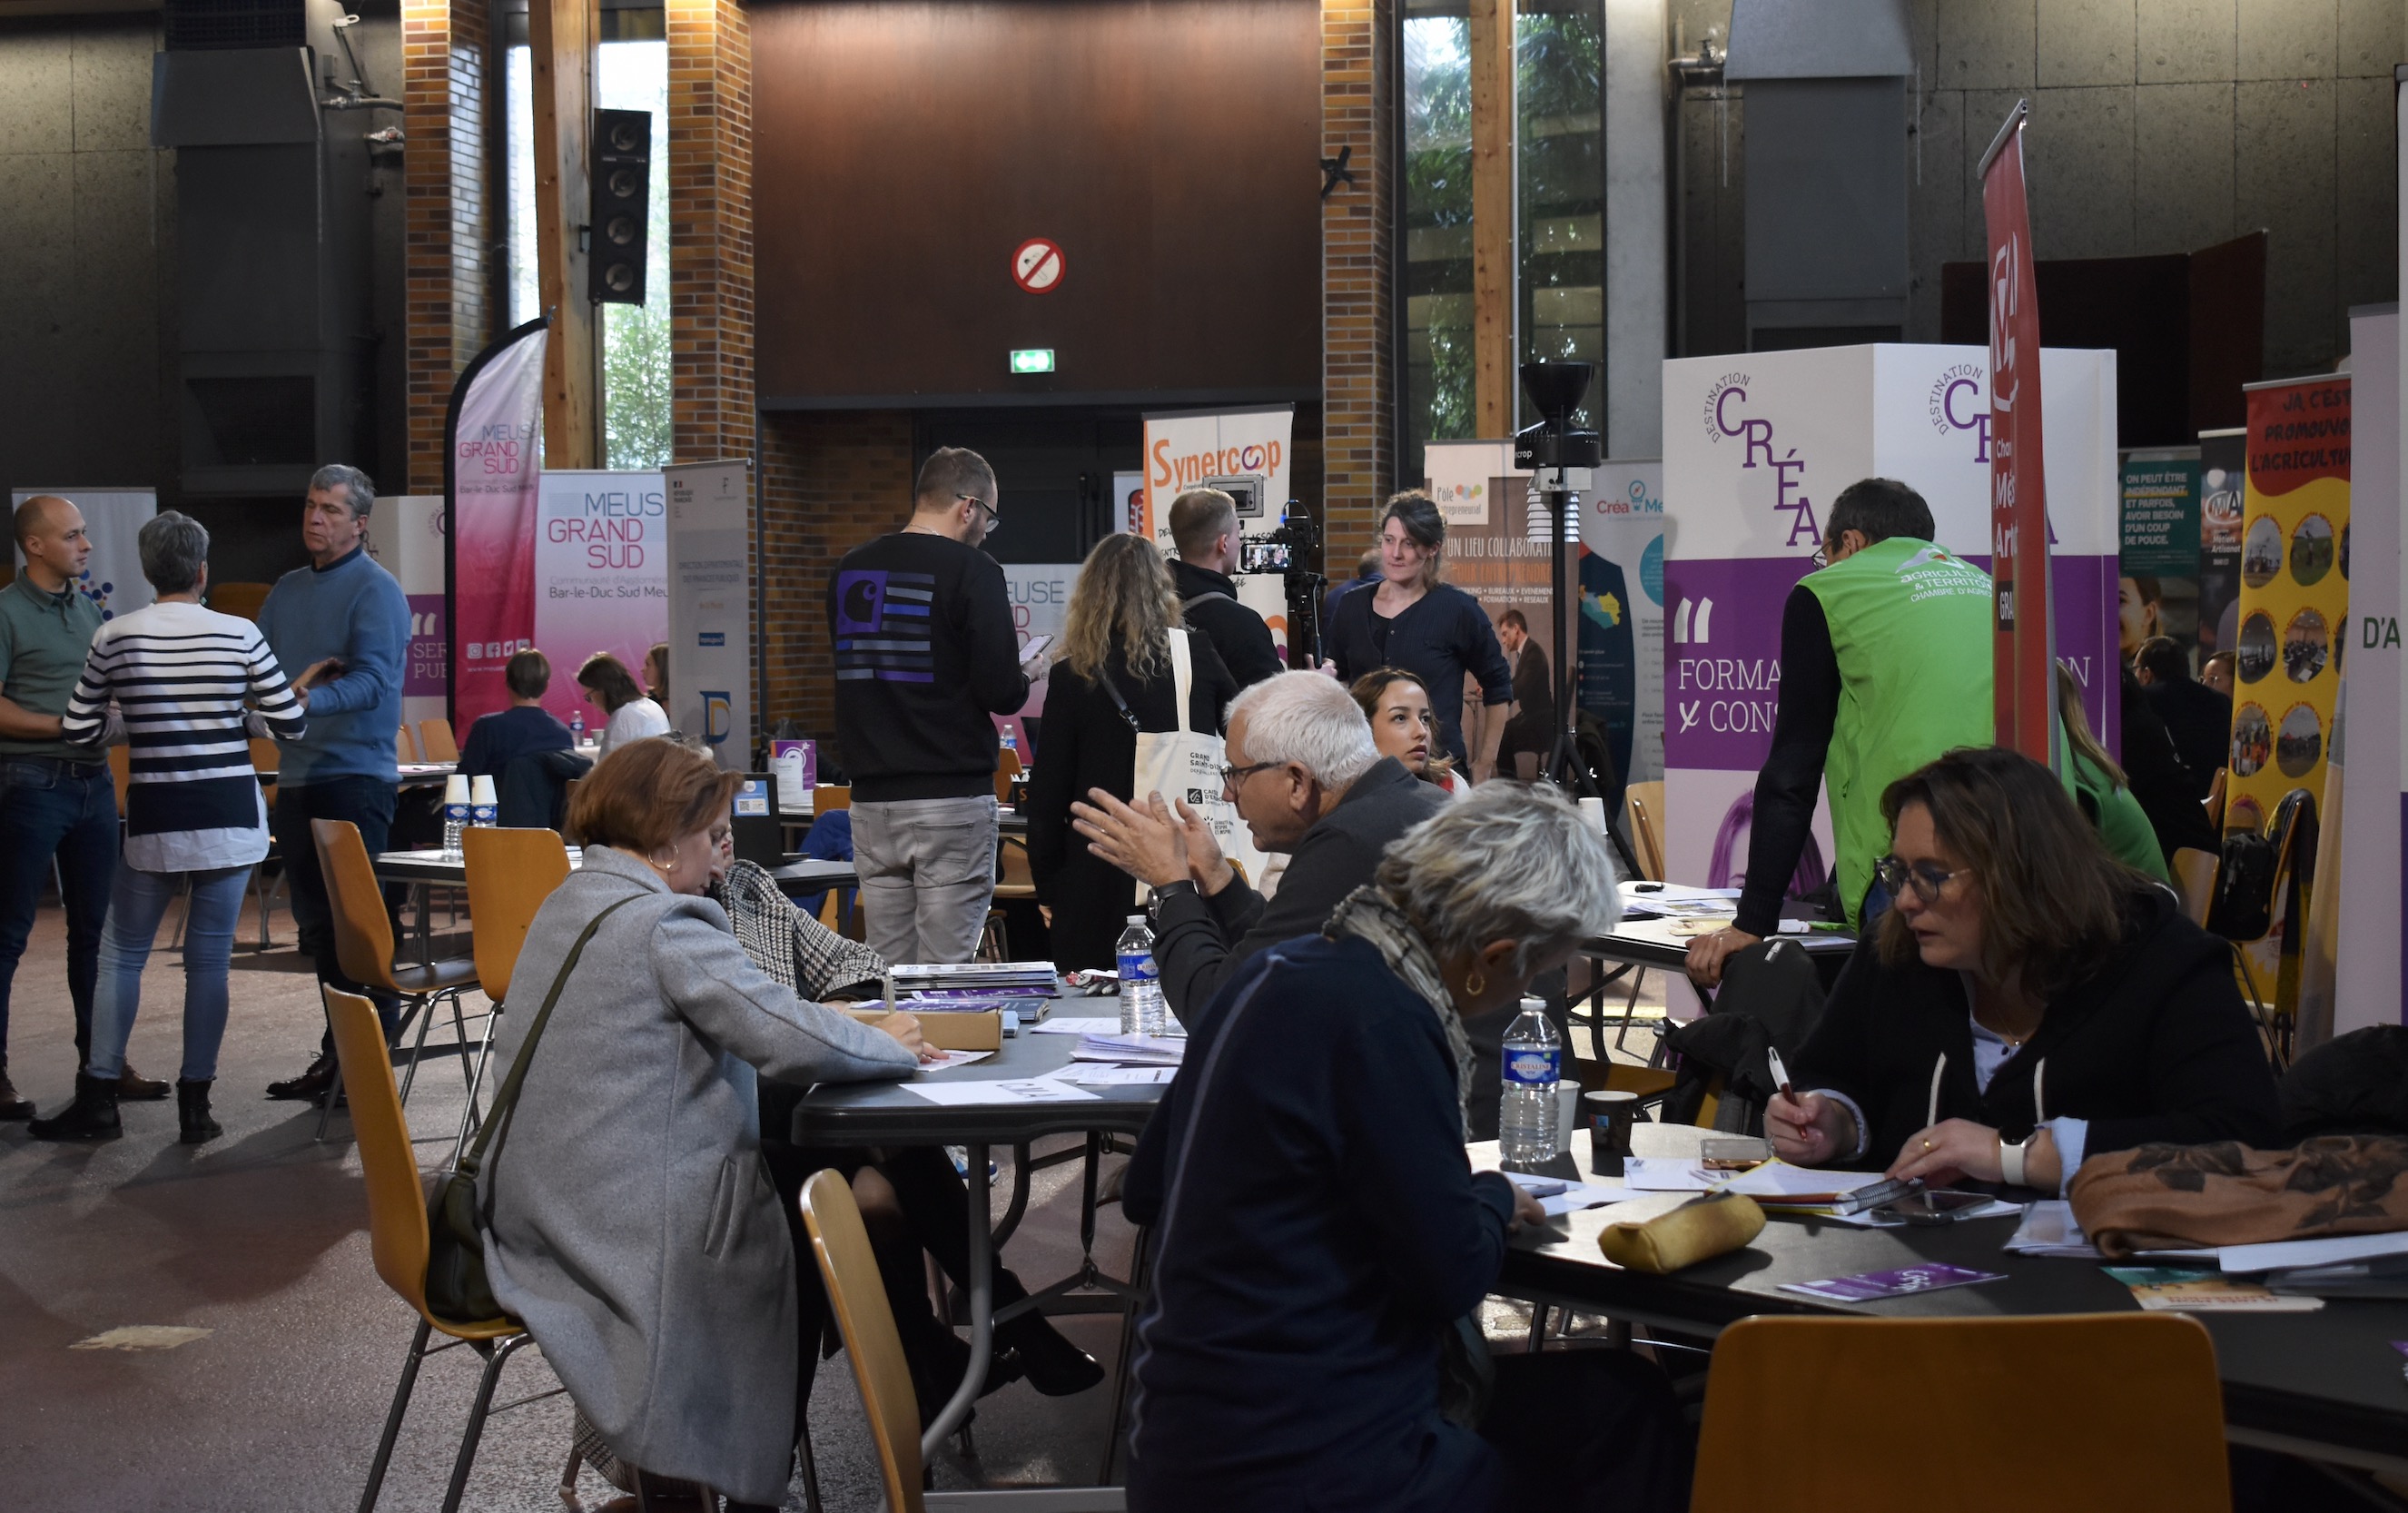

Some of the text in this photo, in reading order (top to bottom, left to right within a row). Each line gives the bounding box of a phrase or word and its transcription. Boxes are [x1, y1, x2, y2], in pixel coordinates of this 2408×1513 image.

[1703, 372, 1751, 443] DESTINATION
[1929, 364, 1983, 436] DESTINATION
[2265, 417, 2351, 441] PROMOUVO
[459, 441, 519, 458] GRAND
[484, 458, 519, 474] SUD
[1153, 439, 1281, 493] Synercoop
[1716, 387, 1822, 547] CRÉA
[2252, 447, 2351, 472] L'AGRICULTU
[2126, 470, 2187, 484] ON PEUT ÊTRE
[1436, 487, 1454, 502] Pôle
[585, 492, 665, 517] MEUS
[1596, 499, 1630, 515] Créa
[2126, 499, 2137, 509] ET
[2125, 509, 2185, 520] AVOIR BESOIN
[548, 518, 644, 543] GRAND
[2125, 522, 2171, 533] D'UN COUP
[1447, 537, 1553, 558] UN LIEU COLLABORATI
[2125, 535, 2137, 545] DE
[587, 544, 645, 569] SUD
[1451, 562, 1552, 583] POUR ENTREPRENDRE
[549, 586, 614, 598] Bar-le-Duc
[617, 586, 640, 598] Sud
[1915, 582, 1924, 590] &
[1524, 596, 1549, 604] RESEAUX
[1910, 588, 1956, 602] CHAMBRE
[2363, 617, 2401, 649] D'A
